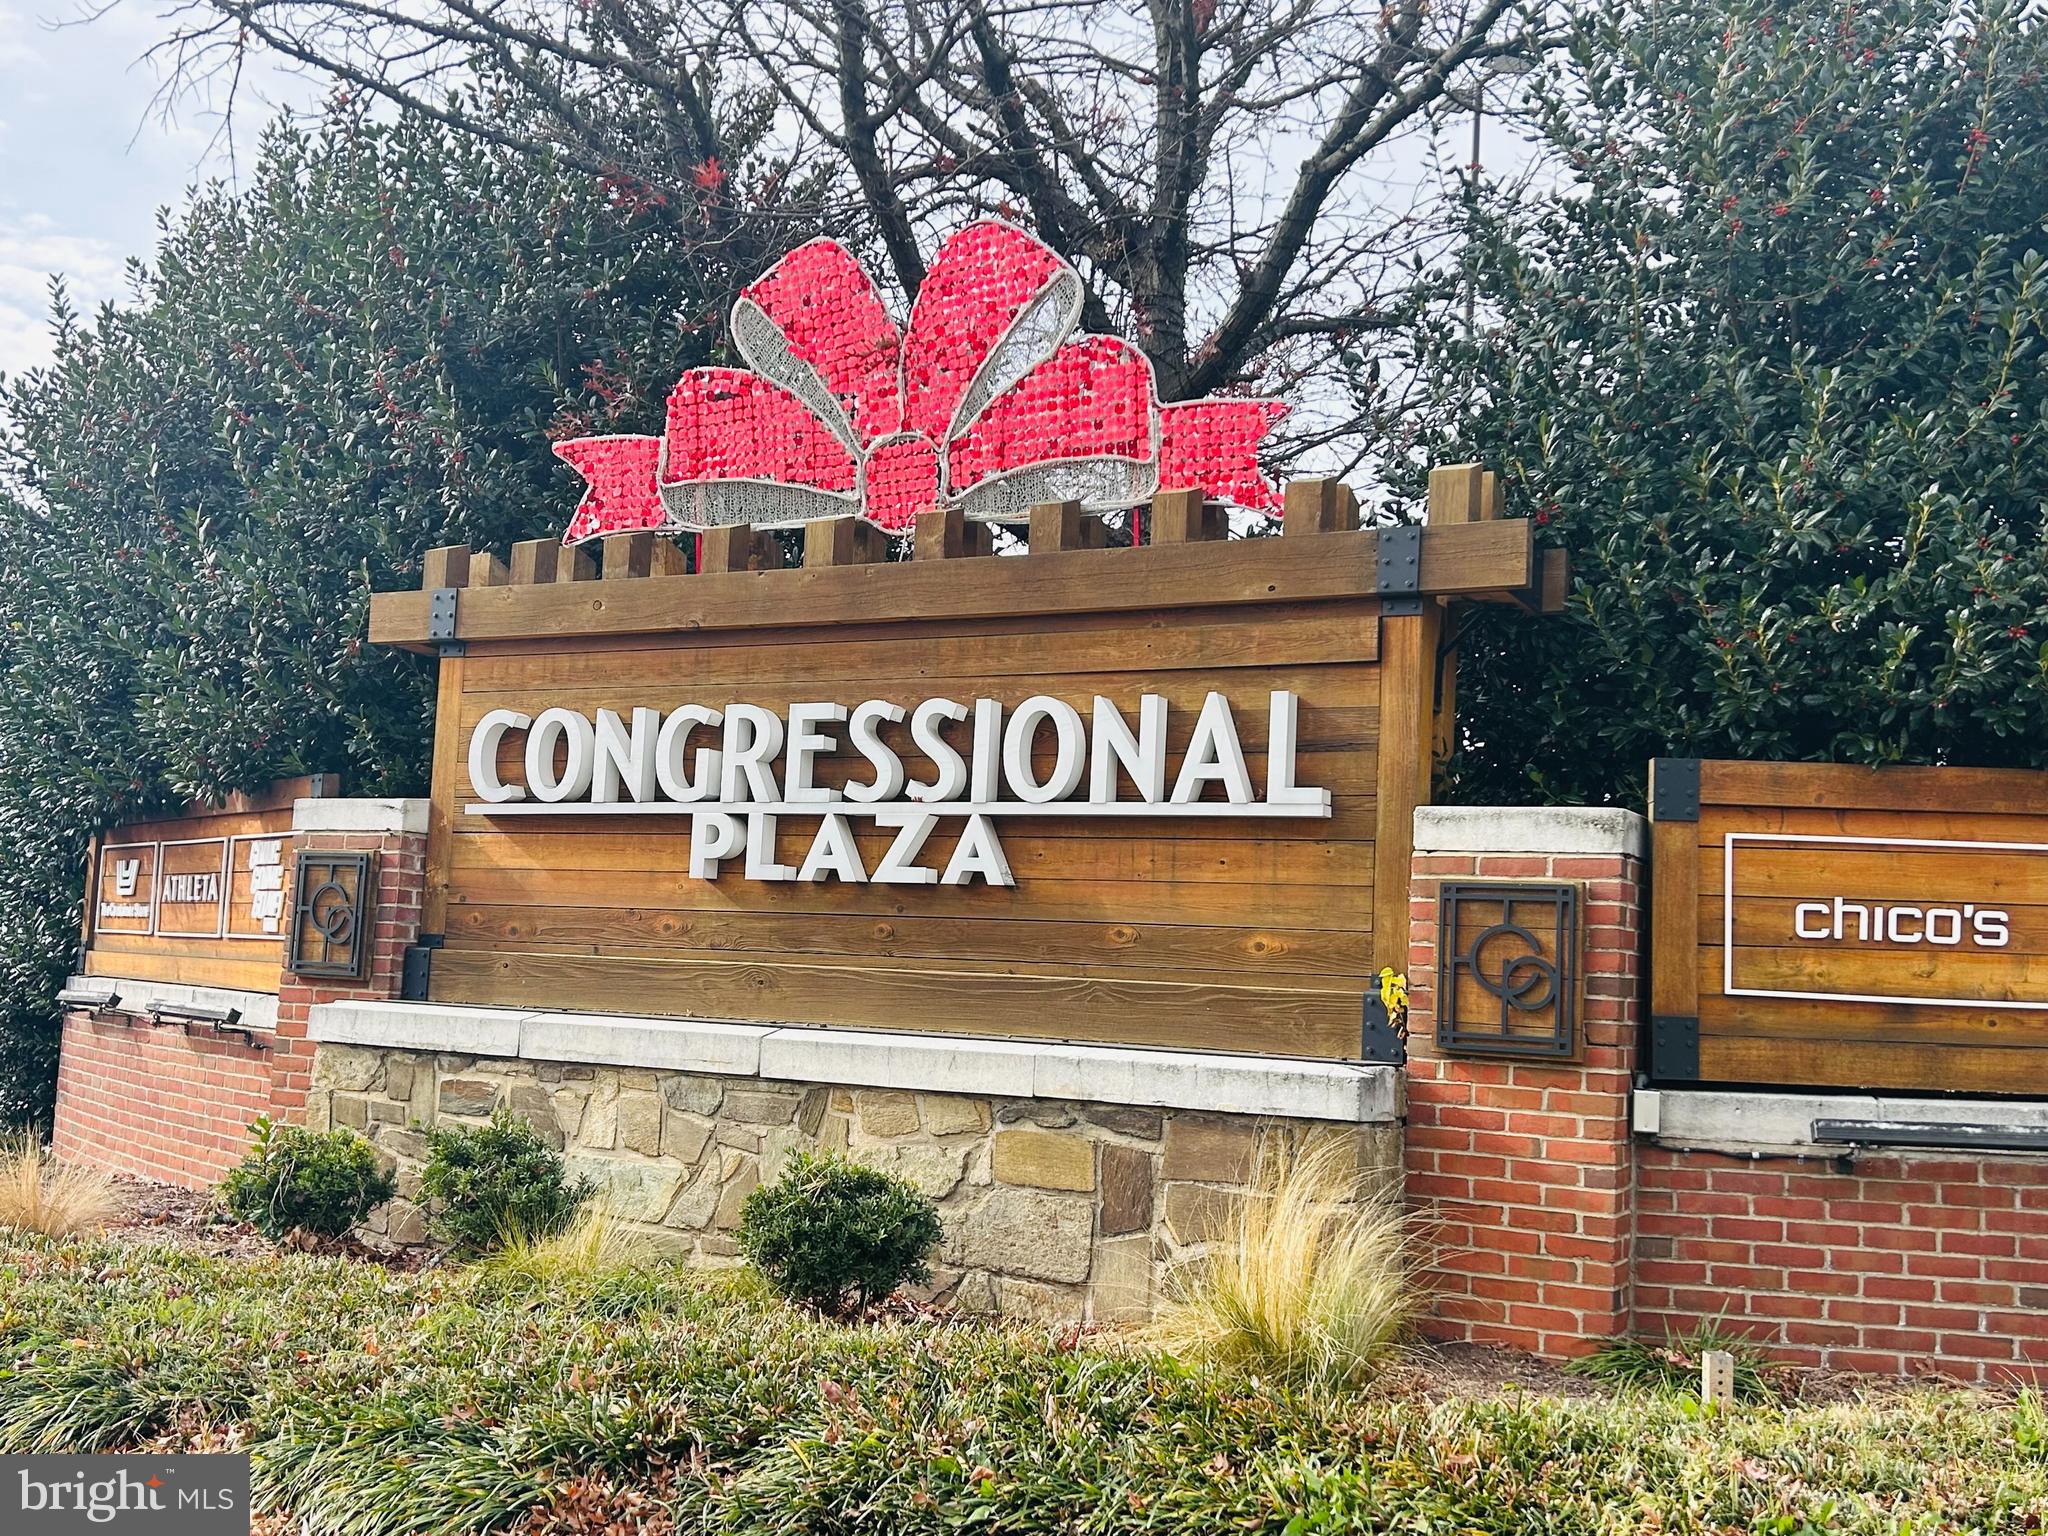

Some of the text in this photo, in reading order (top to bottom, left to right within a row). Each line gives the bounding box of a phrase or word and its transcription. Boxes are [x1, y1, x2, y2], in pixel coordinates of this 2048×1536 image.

[467, 689, 1332, 805] CONGRESSIONAL
[689, 811, 1016, 888] PLAZA
[161, 872, 220, 903] ATHLETA
[1794, 896, 2009, 947] chico's
